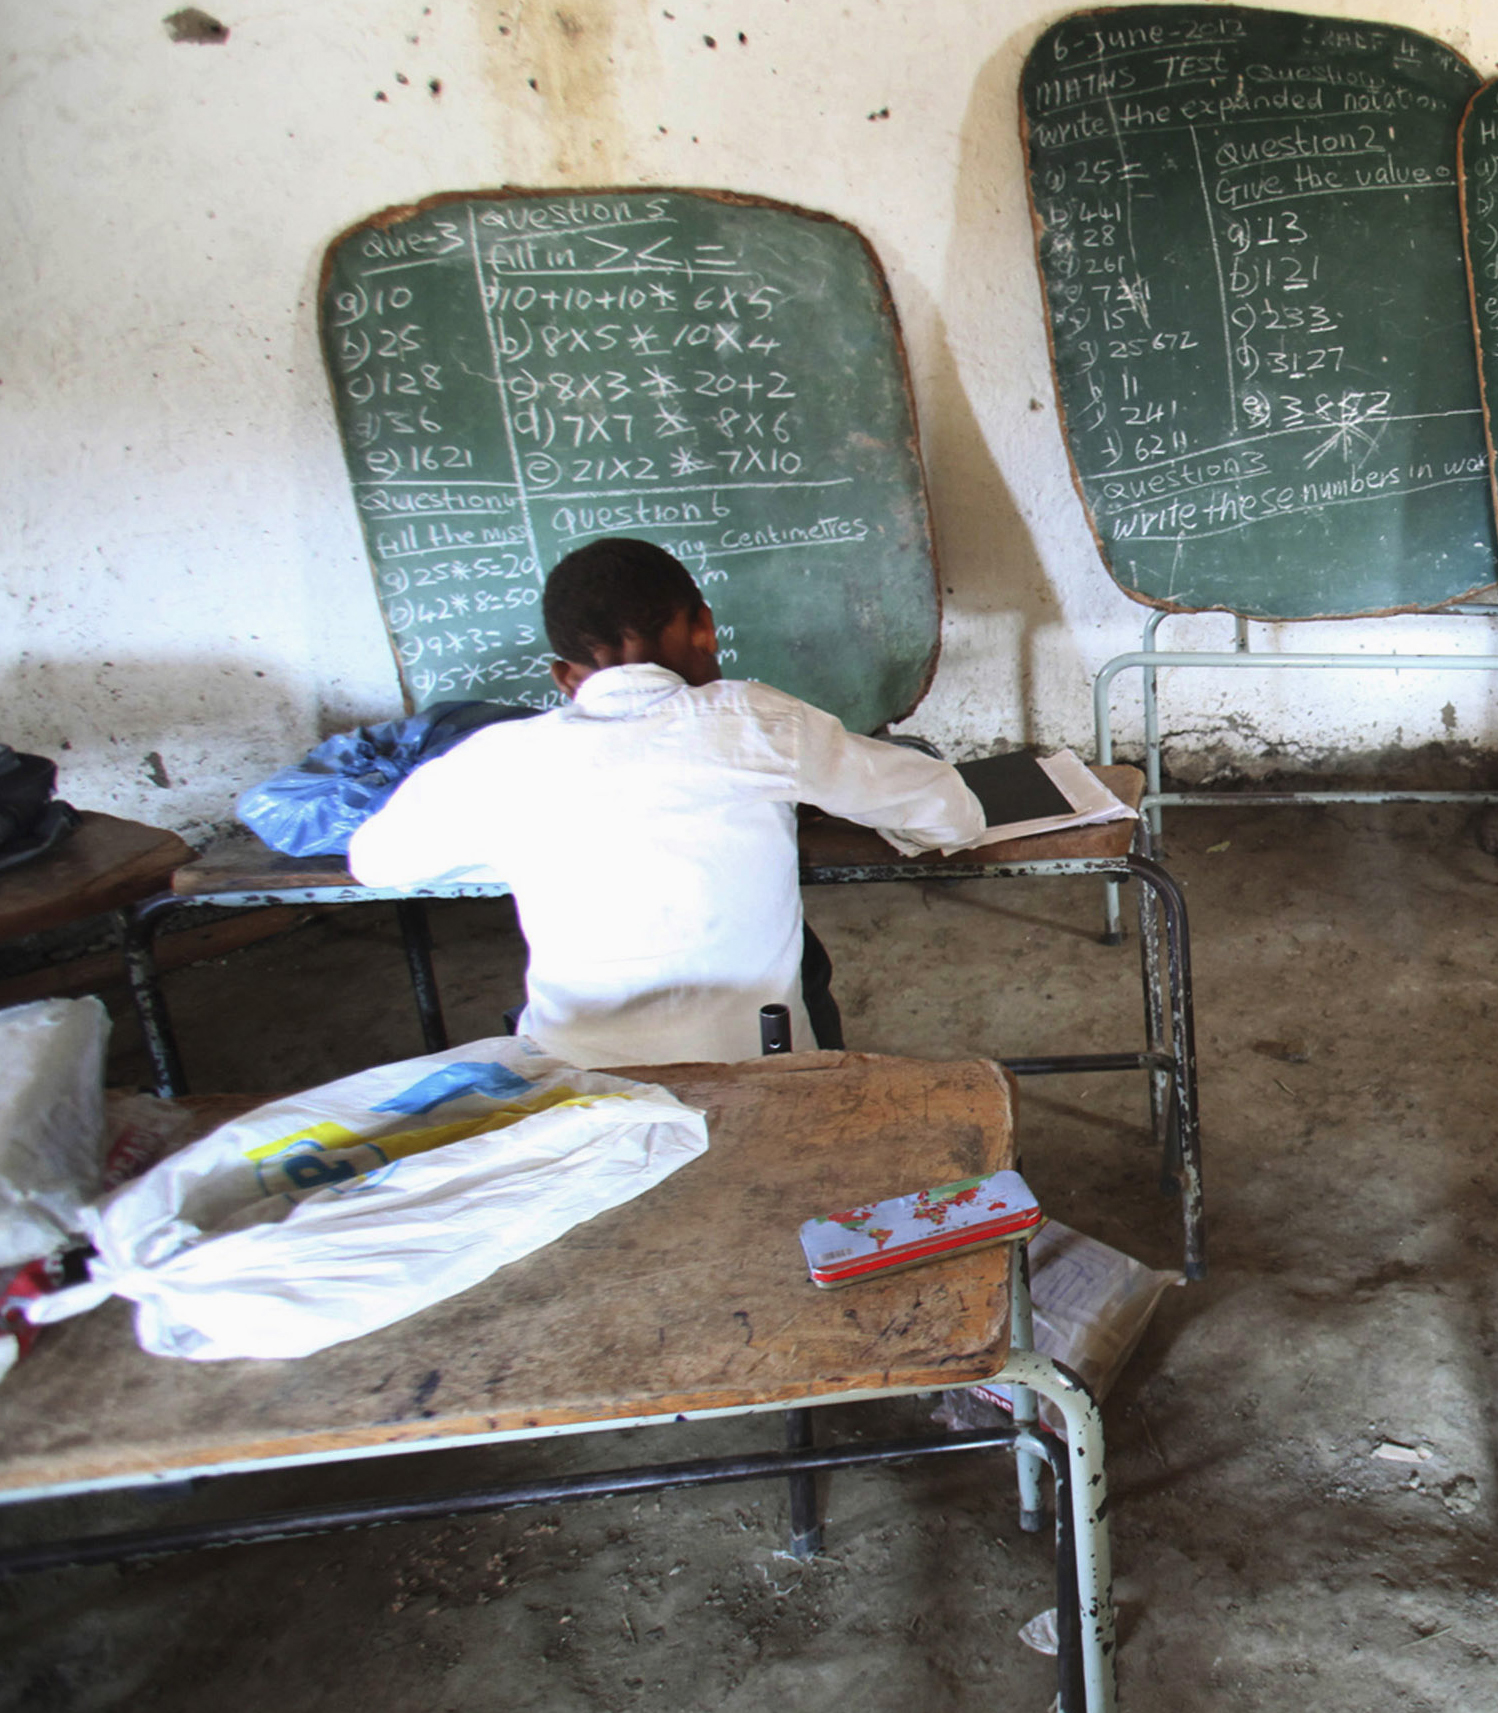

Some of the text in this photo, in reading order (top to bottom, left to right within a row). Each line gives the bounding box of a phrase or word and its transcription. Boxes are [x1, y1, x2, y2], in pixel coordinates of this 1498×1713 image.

[1119, 103, 1171, 127] the
[1296, 163, 1343, 192] the
[1356, 153, 1431, 186] value
[480, 200, 631, 231] Question
[1083, 225, 1115, 247] 28
[548, 249, 576, 268] in
[1202, 488, 1294, 521] these
[1301, 464, 1400, 502] numbers
[1409, 463, 1433, 479] in
[552, 491, 731, 535] Question 6
[428, 522, 475, 547] the
